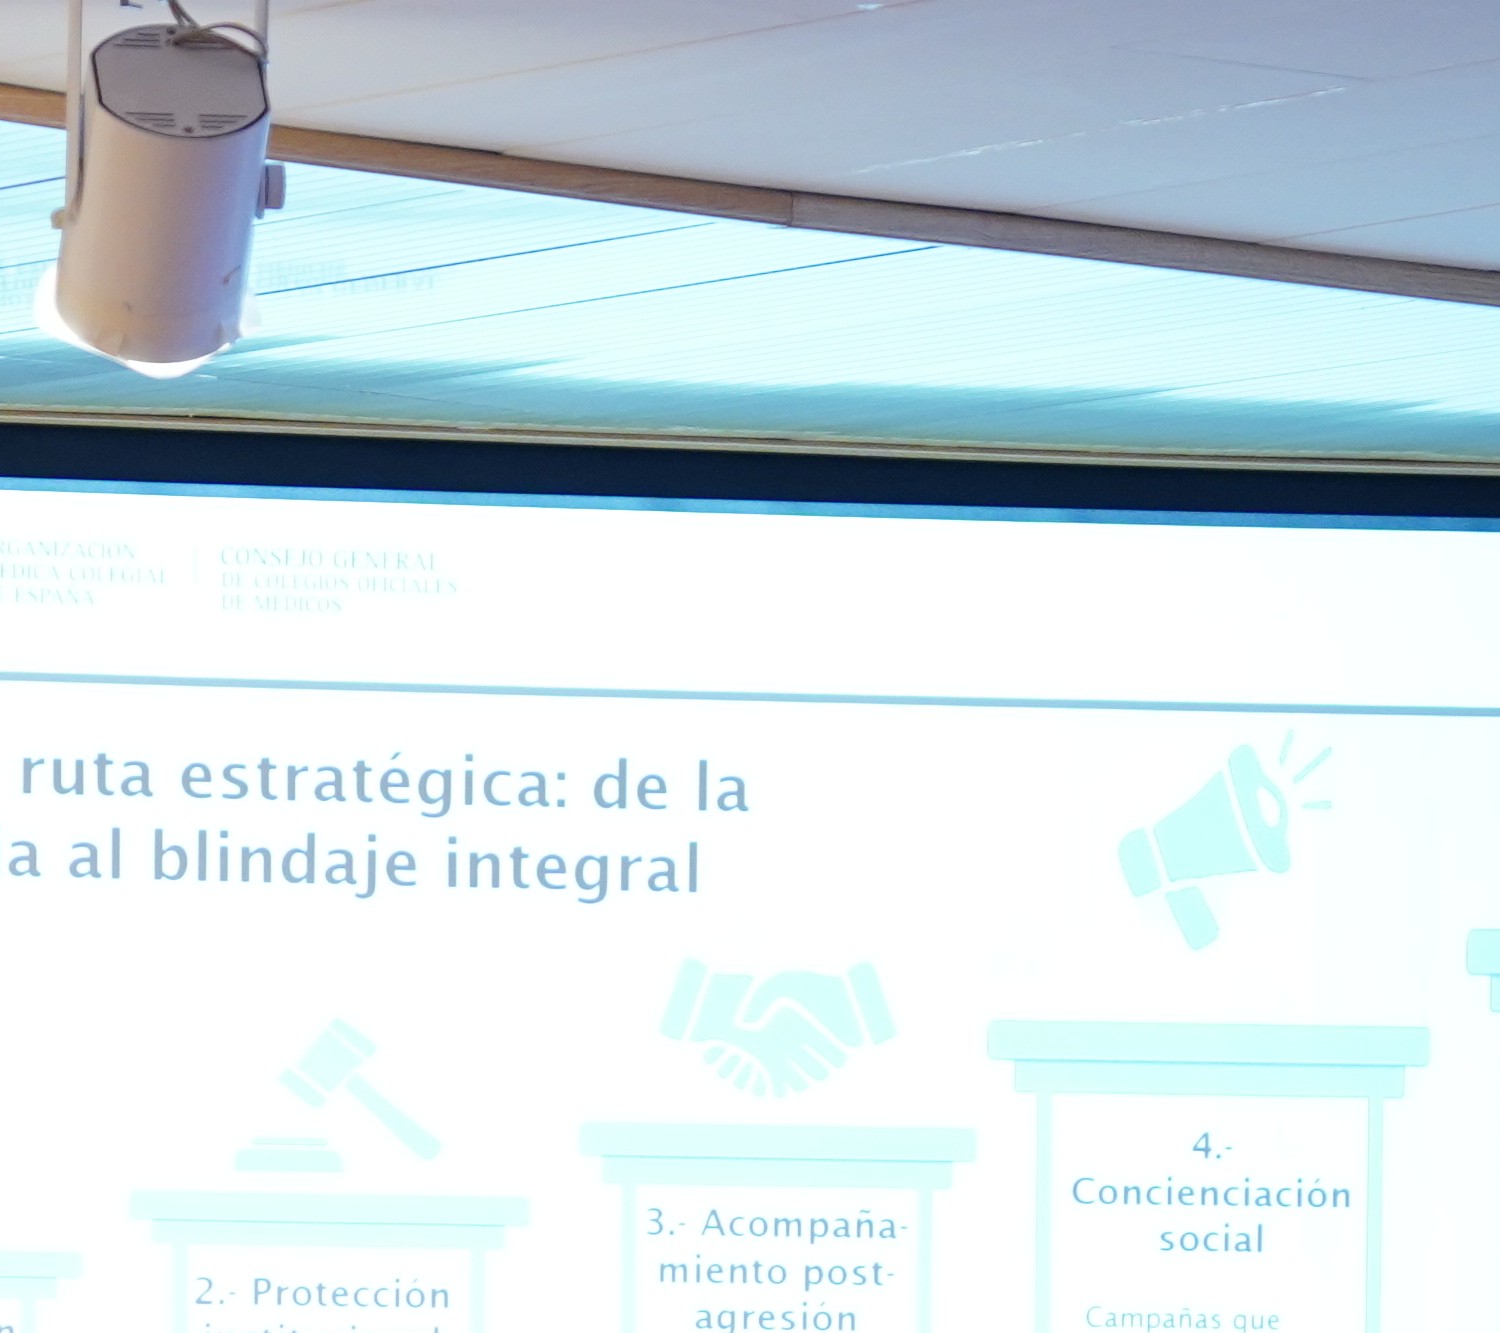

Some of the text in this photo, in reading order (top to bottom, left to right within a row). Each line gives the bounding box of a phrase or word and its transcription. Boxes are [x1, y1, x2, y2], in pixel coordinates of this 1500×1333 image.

[21, 745, 153, 799] ruta
[180, 751, 568, 819] estratégica:
[592, 757, 668, 810] de
[697, 759, 750, 812] la
[67, 827, 121, 881] al
[152, 830, 417, 900] blindaje
[446, 836, 698, 904] integral
[1191, 1131, 1234, 1160] 4.-
[1071, 1176, 1351, 1209] Concienciación
[646, 1207, 910, 1245] 3.- Acompaña-
[1159, 1222, 1265, 1254] social
[658, 1253, 896, 1292] miento post-
[194, 1276, 450, 1309] 2.- Protección
[1085, 1306, 1222, 1333] Campañas
